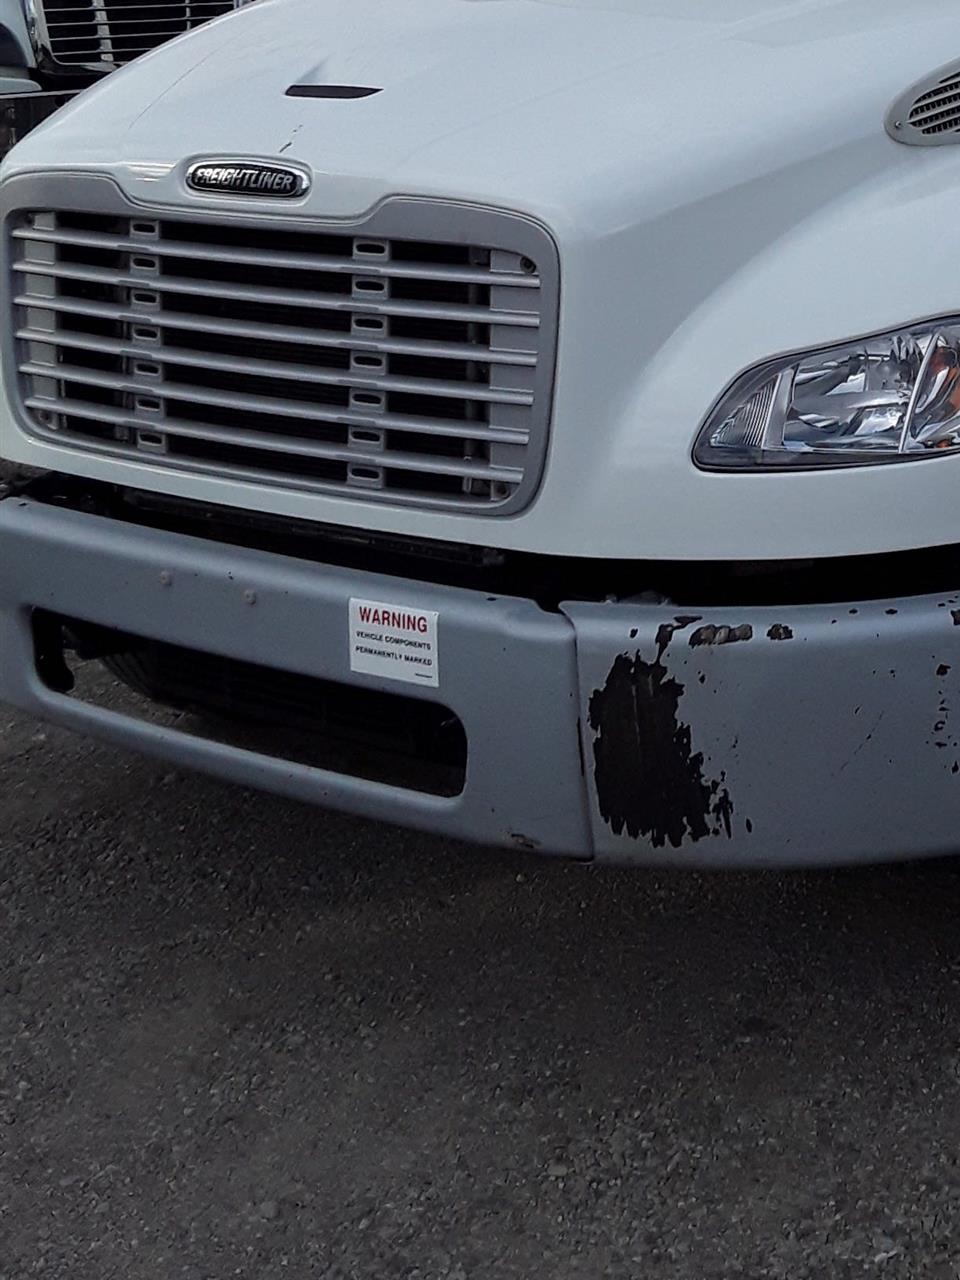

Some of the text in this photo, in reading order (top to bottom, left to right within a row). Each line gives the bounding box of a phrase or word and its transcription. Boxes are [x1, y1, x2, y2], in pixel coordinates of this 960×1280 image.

[195, 168, 294, 190] FREIGHTLINER
[359, 606, 428, 633] WARNING
[356, 631, 432, 651] VEHICLE COMPONENTS
[355, 645, 433, 666] PERMANENTLY MARKED
